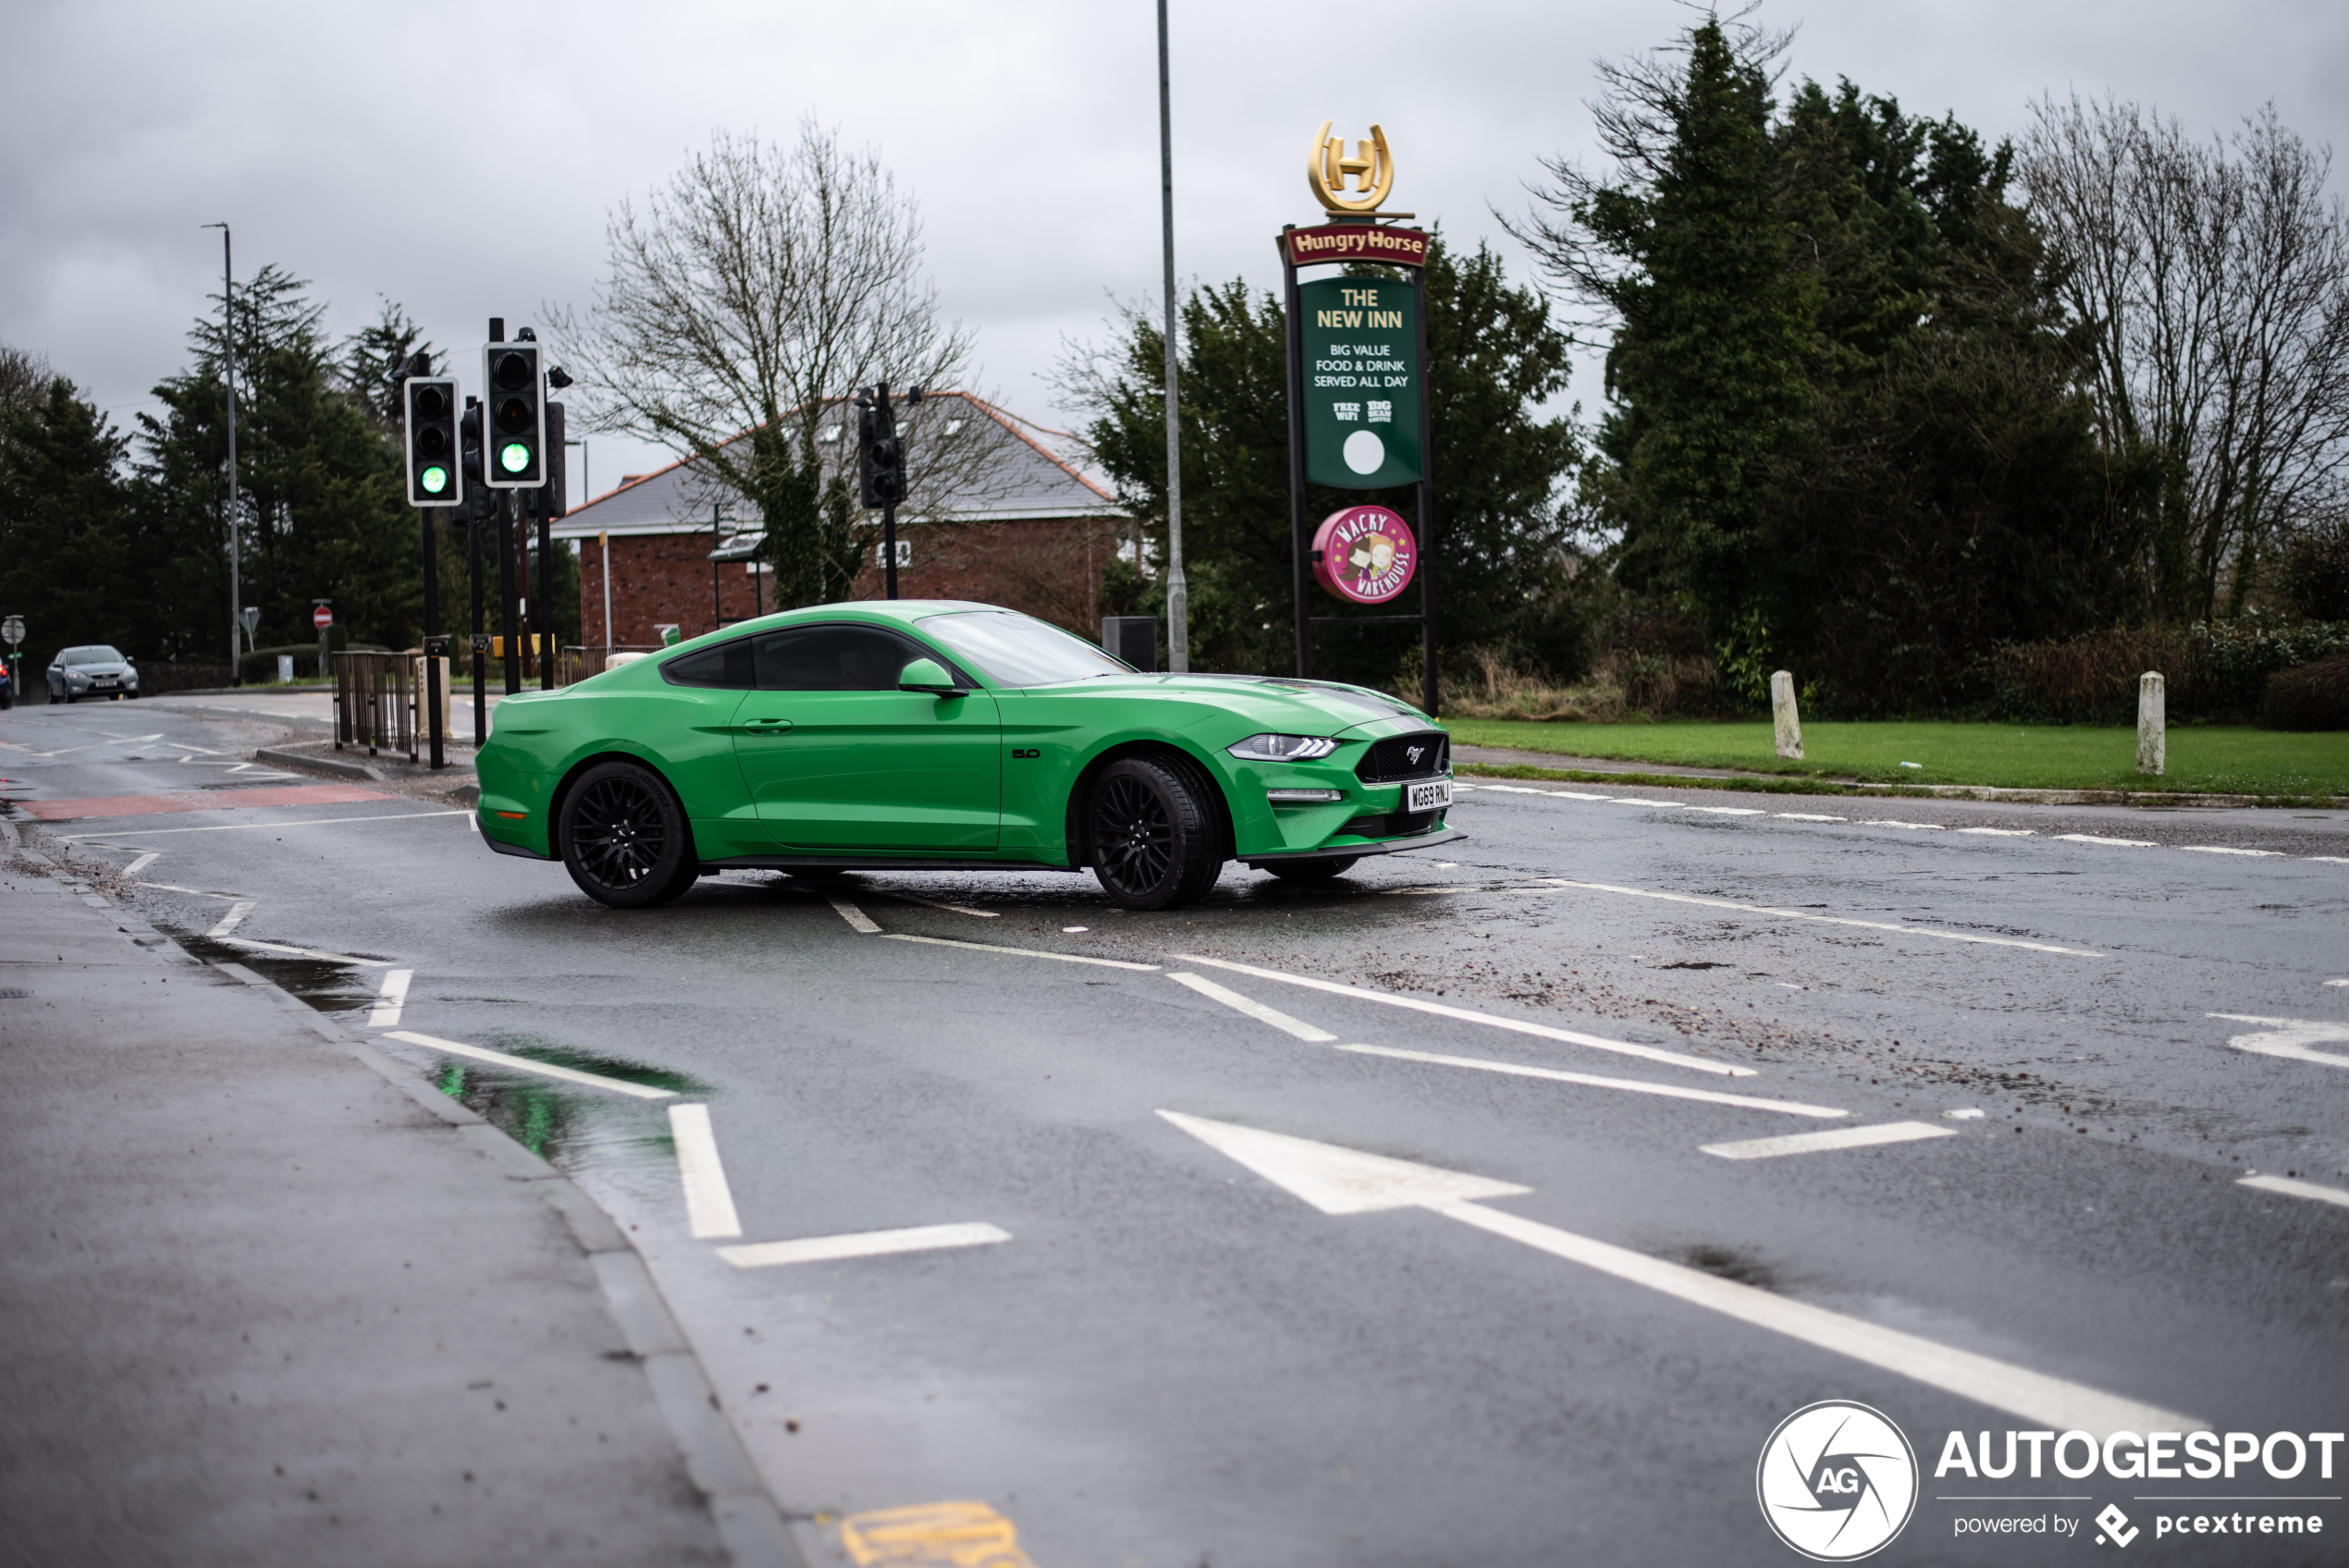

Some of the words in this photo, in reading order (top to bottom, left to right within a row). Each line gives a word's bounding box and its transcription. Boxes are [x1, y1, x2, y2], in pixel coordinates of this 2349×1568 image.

[1341, 288, 1378, 306] THE
[1317, 310, 1362, 327] NEW
[1368, 311, 1402, 328] INN
[1330, 345, 1350, 356] BIG
[1353, 345, 1391, 356] VALUE
[1316, 360, 1352, 371] FOOD
[1355, 361, 1363, 372] &
[1366, 361, 1406, 372] DRINK
[1314, 375, 1357, 386] SERVED
[1359, 376, 1381, 387] ALL
[1384, 376, 1408, 387] DAY
[1333, 402, 1360, 412] FREE
[1367, 400, 1392, 410] BIG
[1336, 513, 1388, 543] WACKY
[1357, 552, 1410, 595] WAREHOUSE
[1012, 748, 1040, 758] 5.0
[1412, 786, 1434, 807] WG69
[1435, 783, 1449, 803] RNJ
